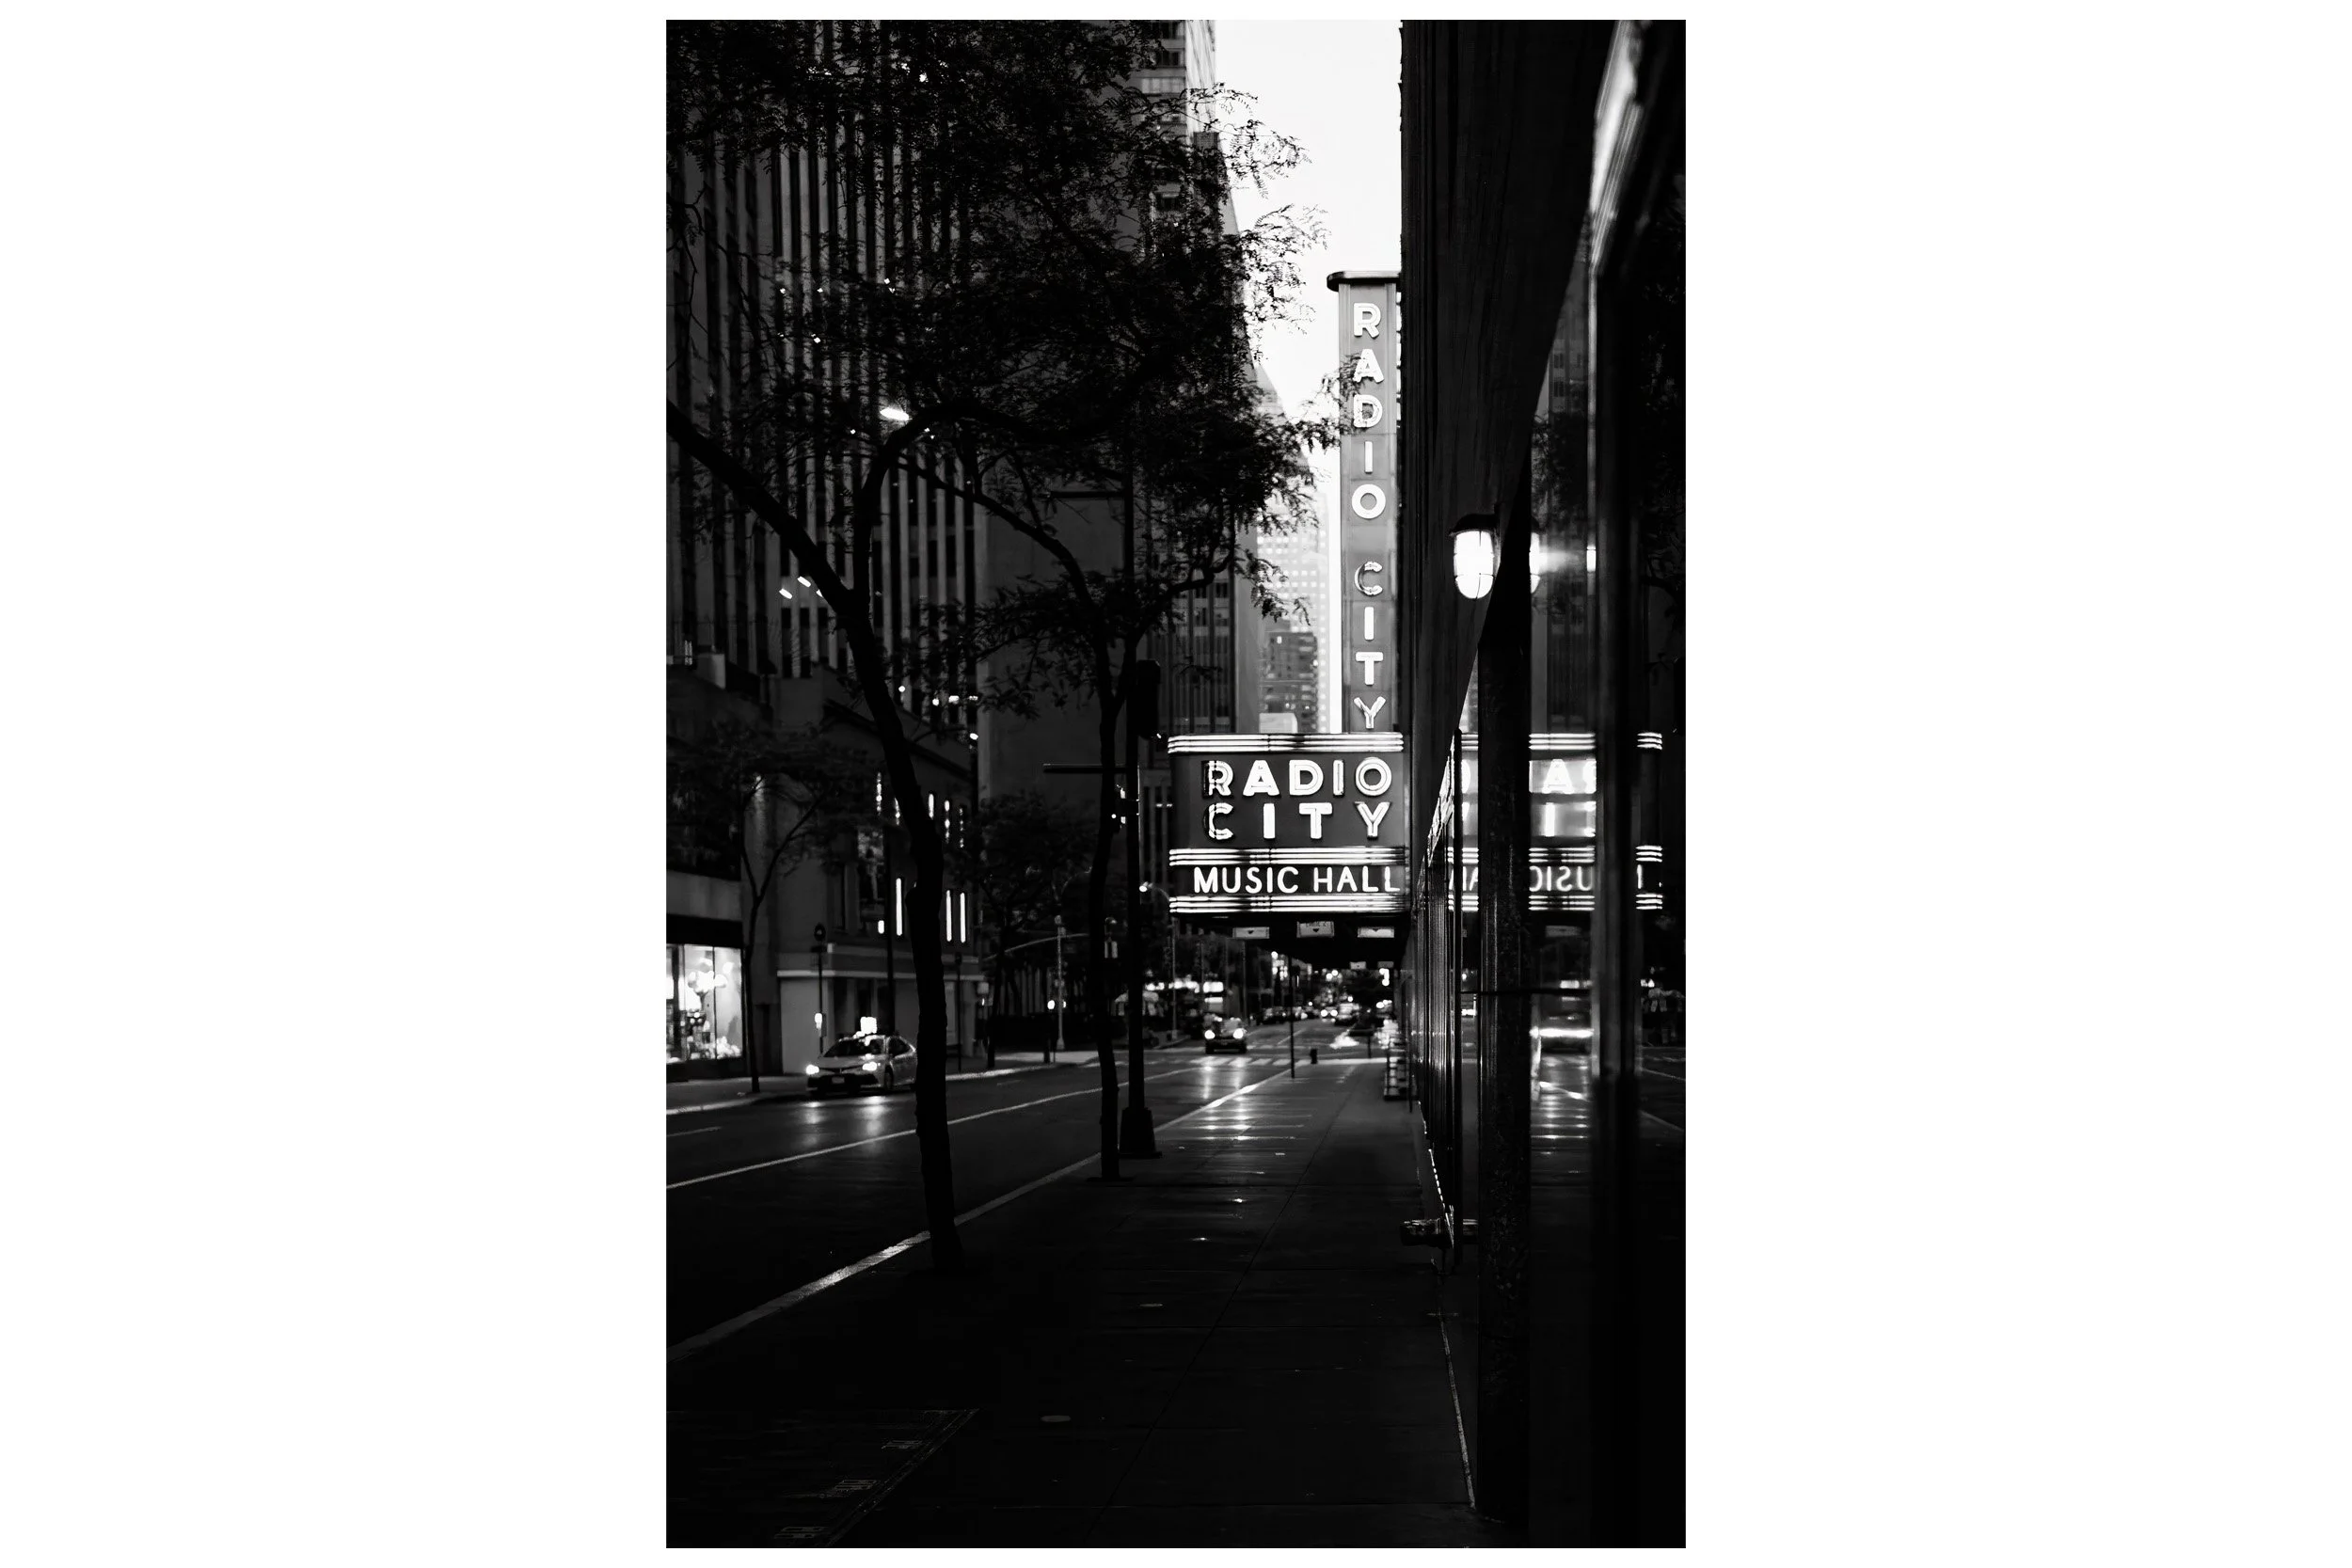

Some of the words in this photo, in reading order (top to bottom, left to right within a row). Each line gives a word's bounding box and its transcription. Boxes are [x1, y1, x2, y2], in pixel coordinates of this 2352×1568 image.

[1351, 302, 1387, 519] RADIO
[1353, 560, 1388, 730] CITY
[1200, 756, 1393, 799] RADIO
[1203, 800, 1391, 841] CITY
[1192, 865, 1300, 894] MUSIC
[1312, 865, 1401, 893] HALL
